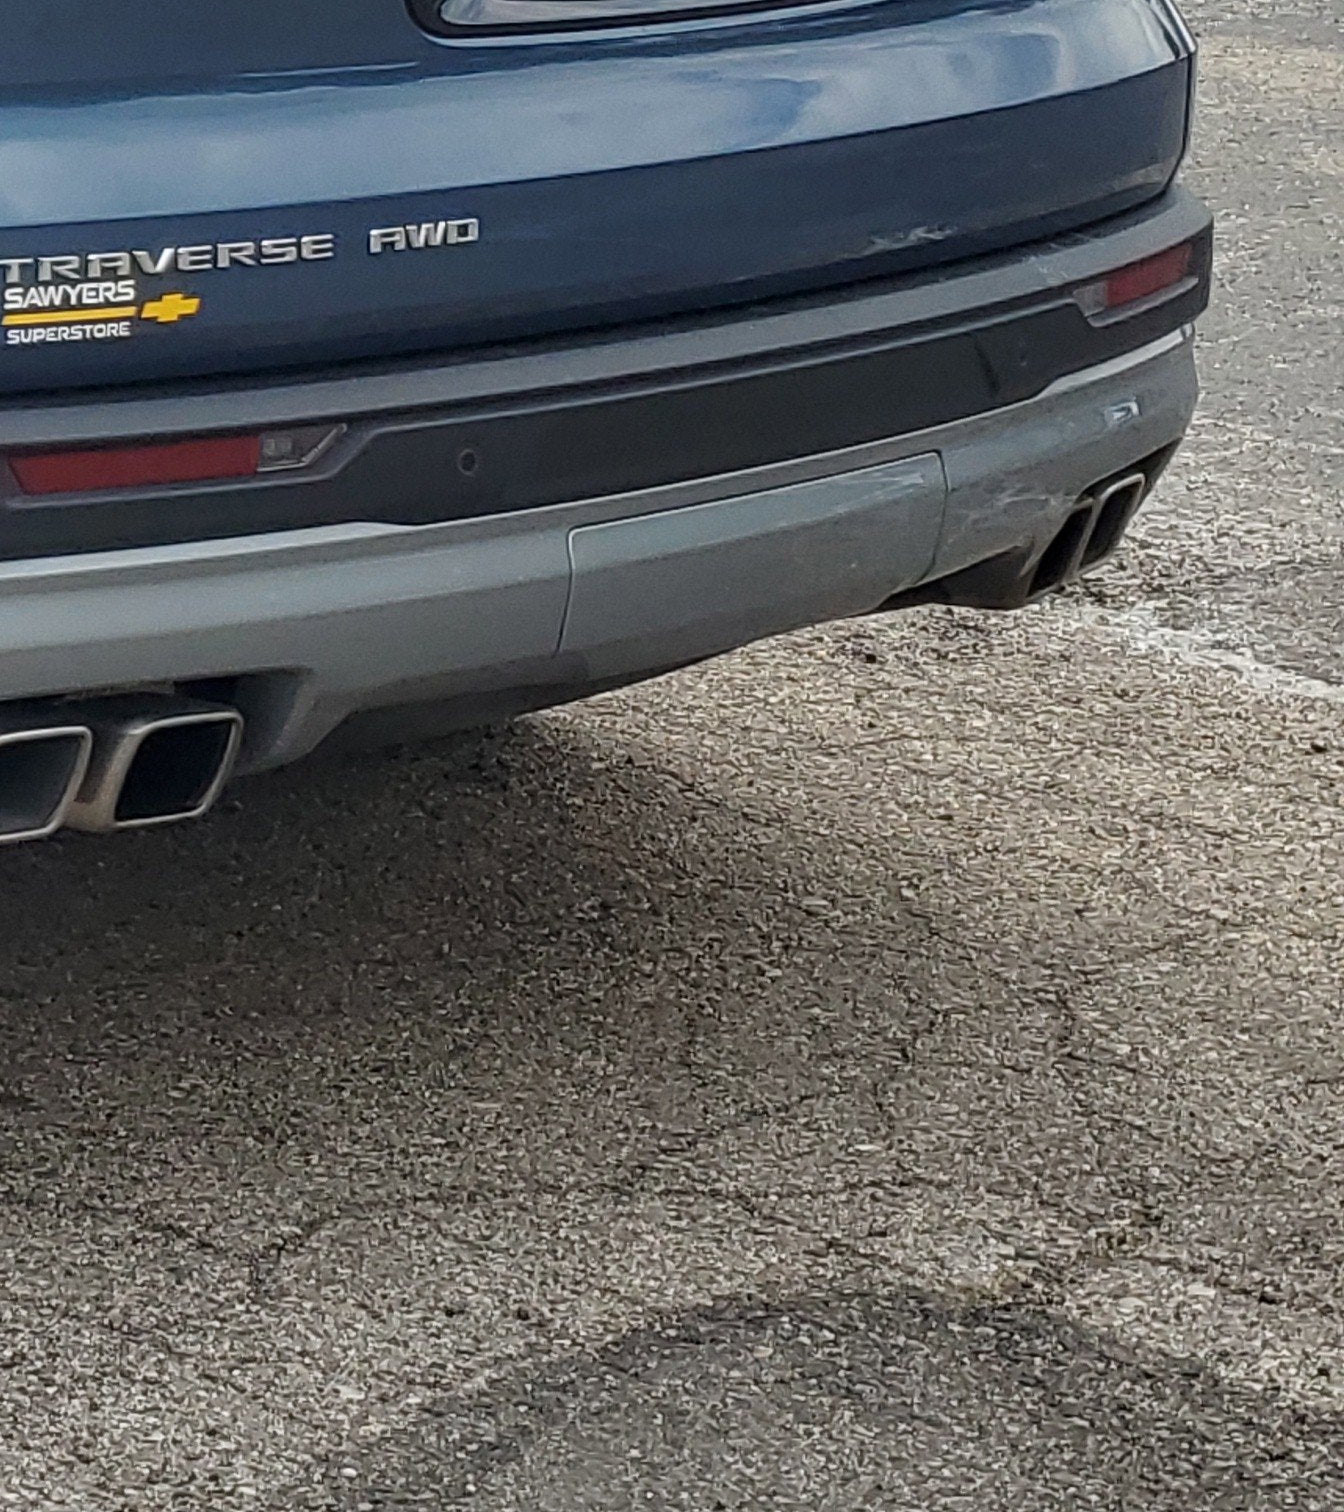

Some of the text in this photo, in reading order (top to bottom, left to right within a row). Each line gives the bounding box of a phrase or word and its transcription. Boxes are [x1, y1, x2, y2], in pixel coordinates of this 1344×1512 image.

[369, 218, 479, 254] AWD
[4, 280, 135, 310] SAWYERS
[6, 320, 132, 346] SUPERSTORE
